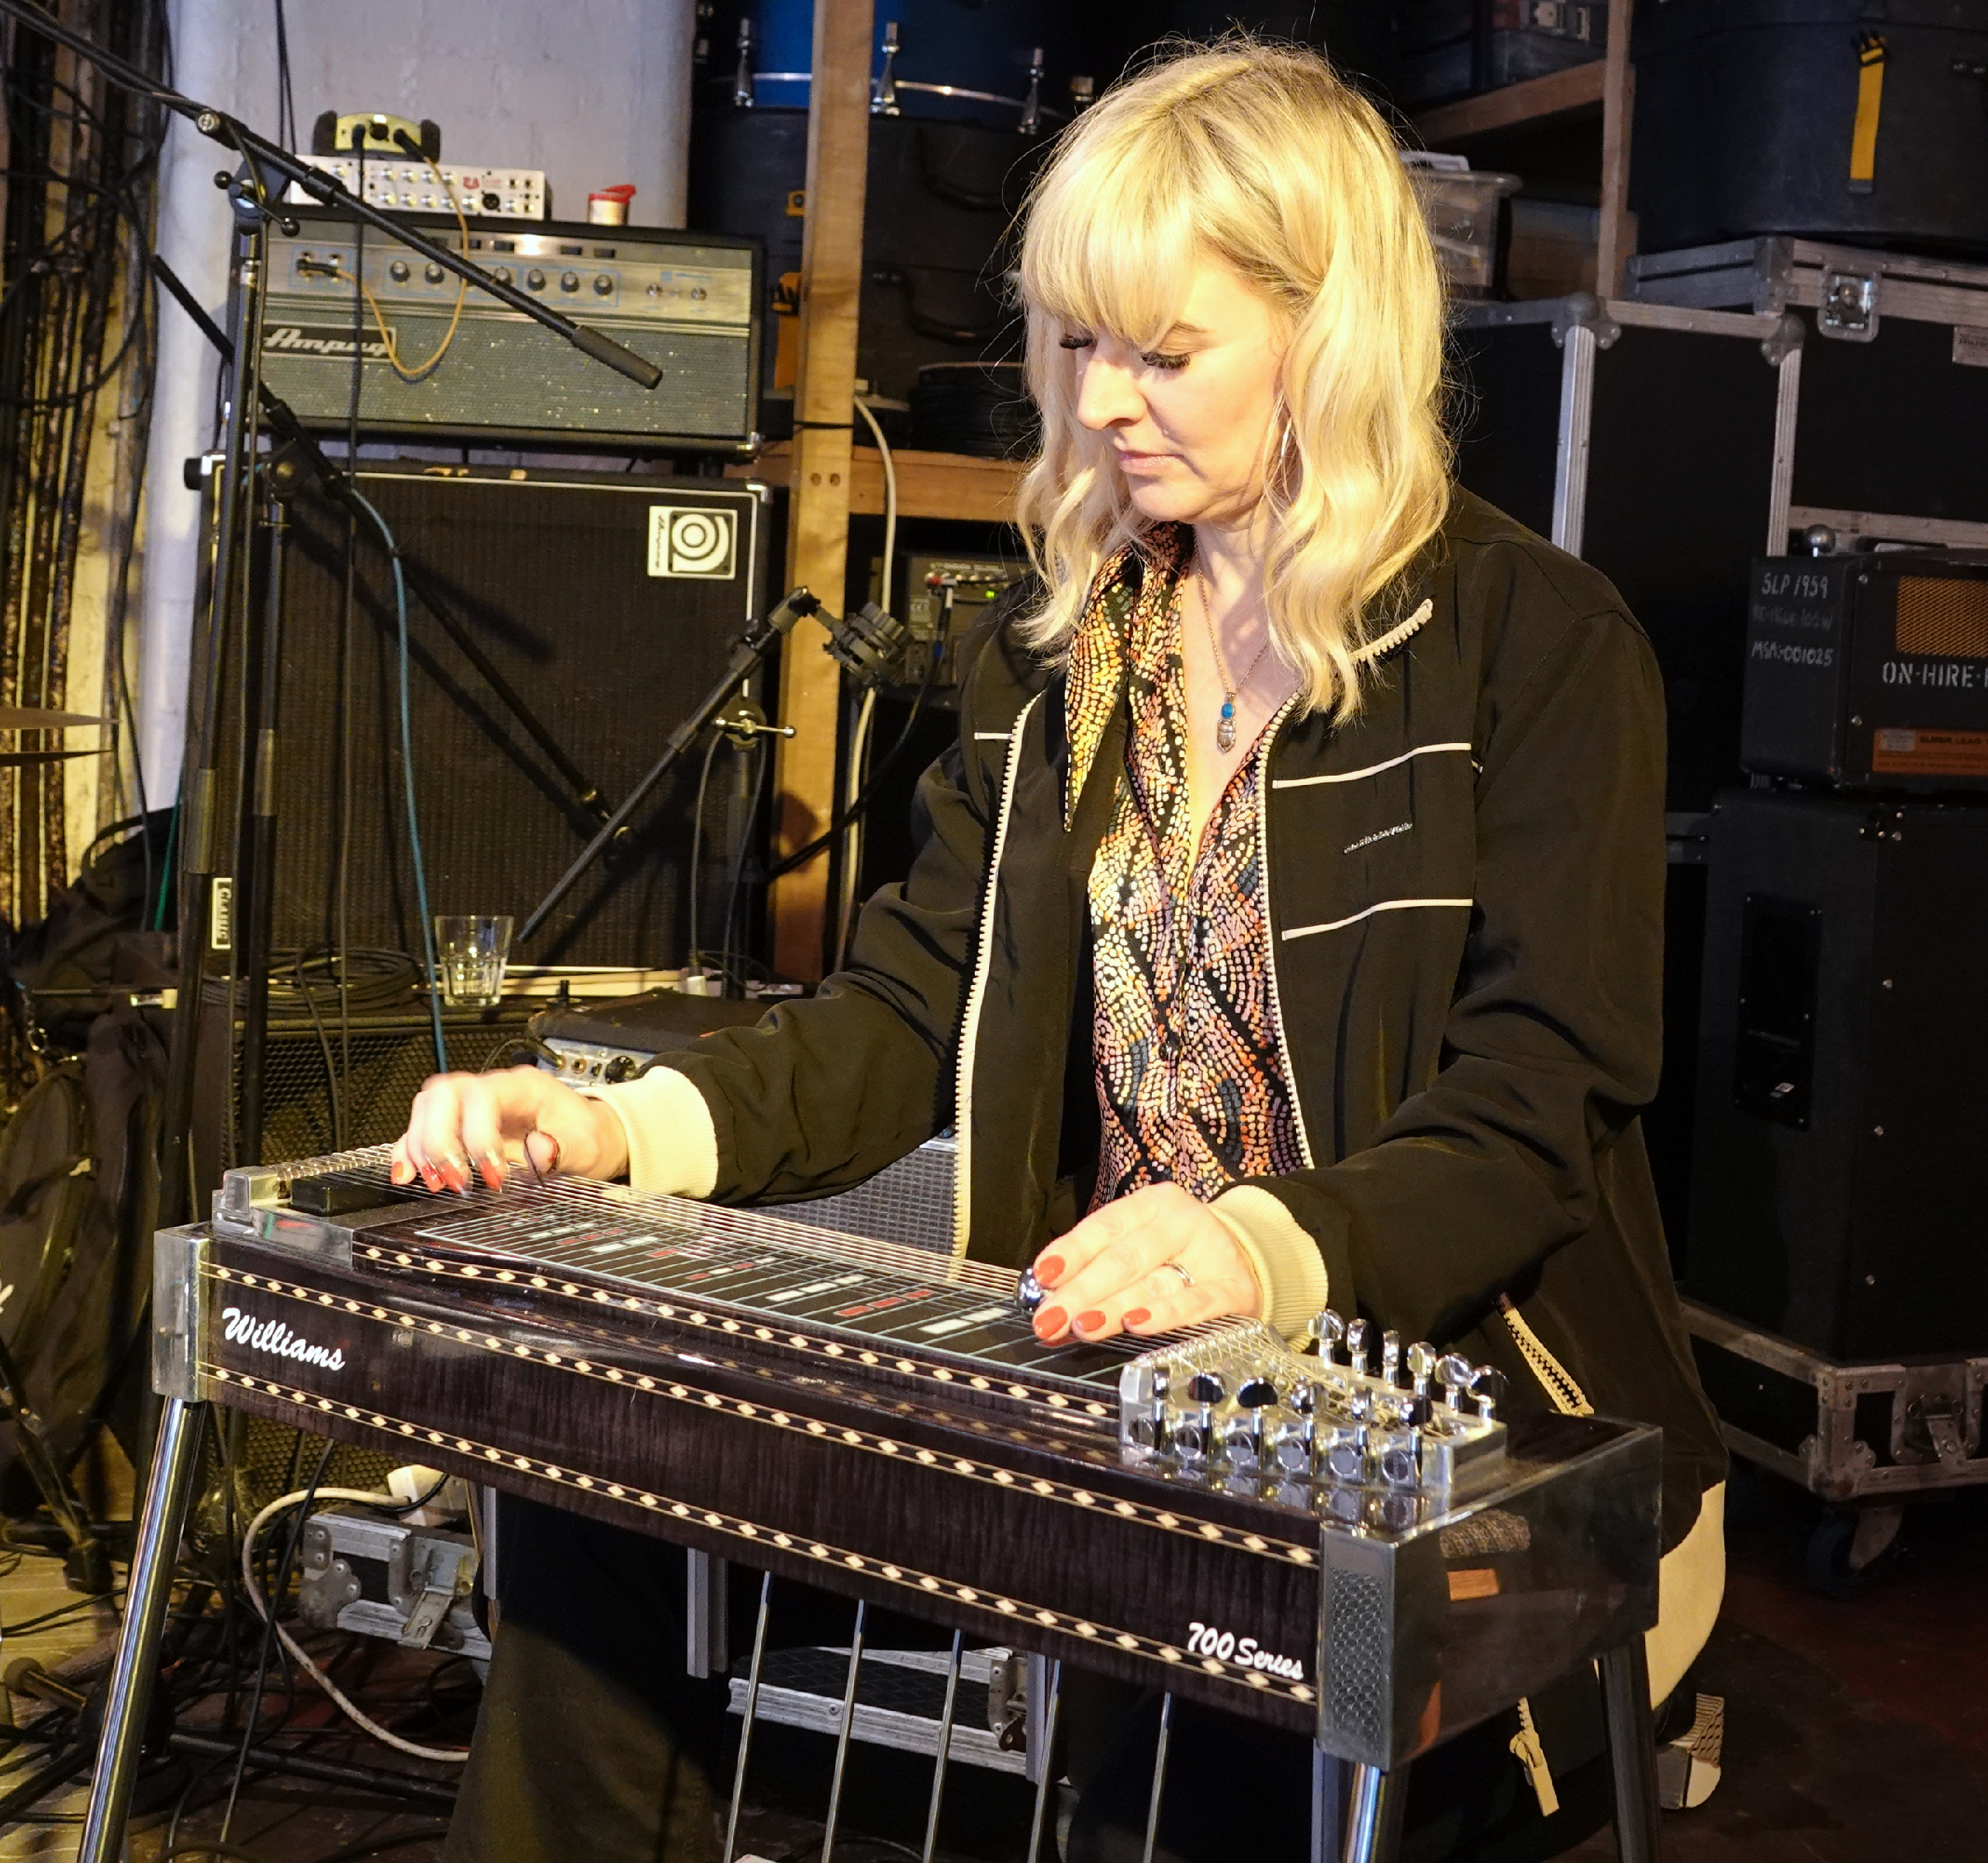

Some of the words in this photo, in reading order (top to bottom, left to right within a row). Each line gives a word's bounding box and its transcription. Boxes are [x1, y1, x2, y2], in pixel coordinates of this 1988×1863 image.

[1762, 572, 1790, 595] SLP
[1794, 575, 1829, 599] 1959
[222, 1307, 346, 1371] Williams
[1188, 1622, 1235, 1661] 700
[1234, 1637, 1304, 1681] Series
